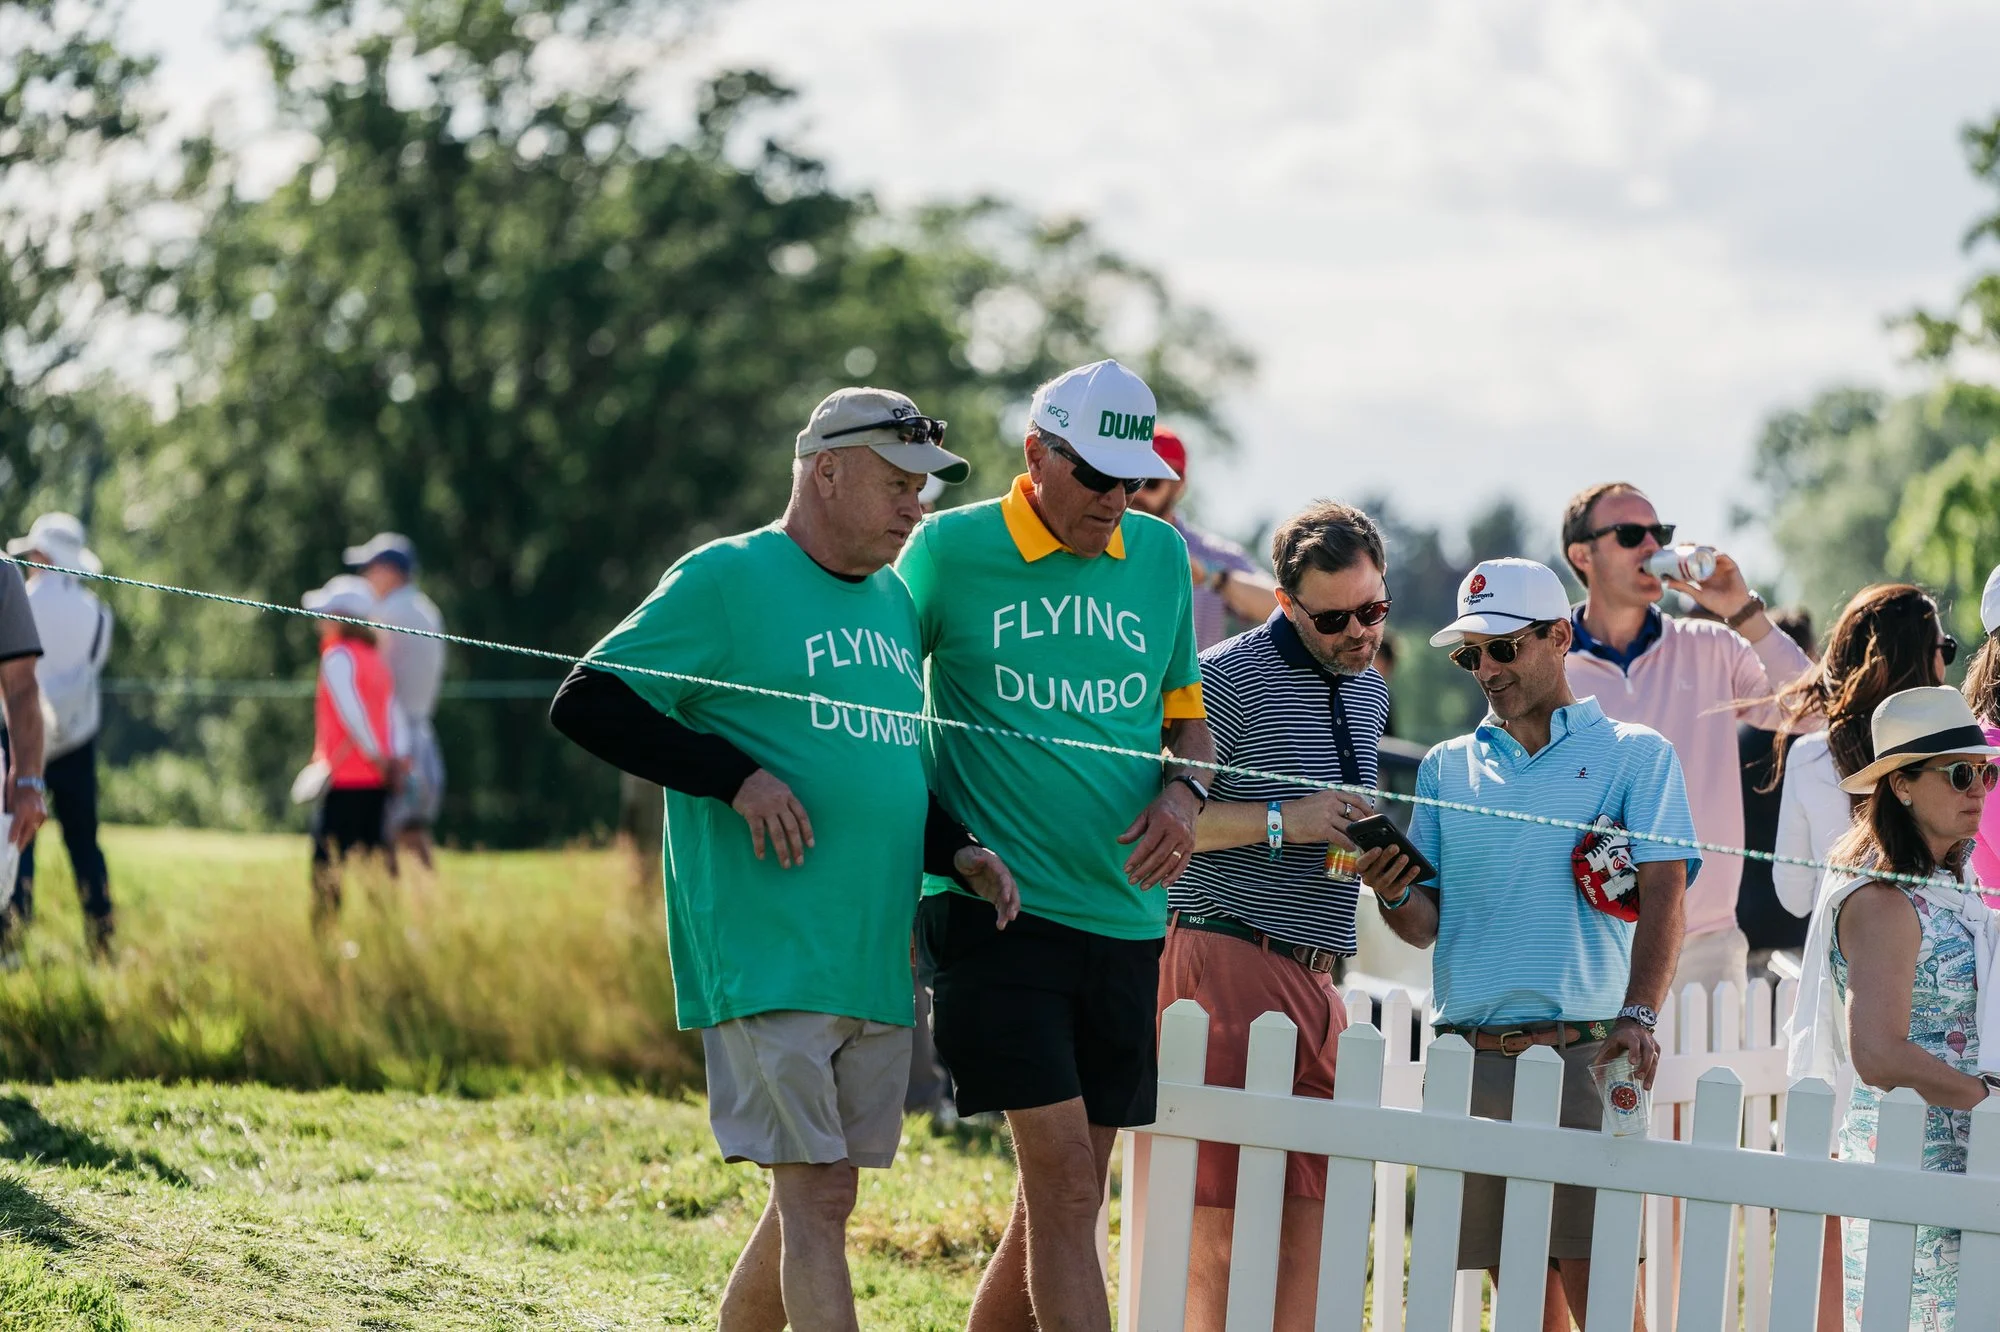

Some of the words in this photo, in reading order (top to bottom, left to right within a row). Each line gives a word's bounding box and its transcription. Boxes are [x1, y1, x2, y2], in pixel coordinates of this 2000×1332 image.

[1098, 410, 1156, 441] DUMB
[993, 595, 1146, 654] FLYING
[805, 628, 923, 693] FLYING
[995, 664, 1147, 714] DUMBO
[1189, 916, 1205, 924] 1923
